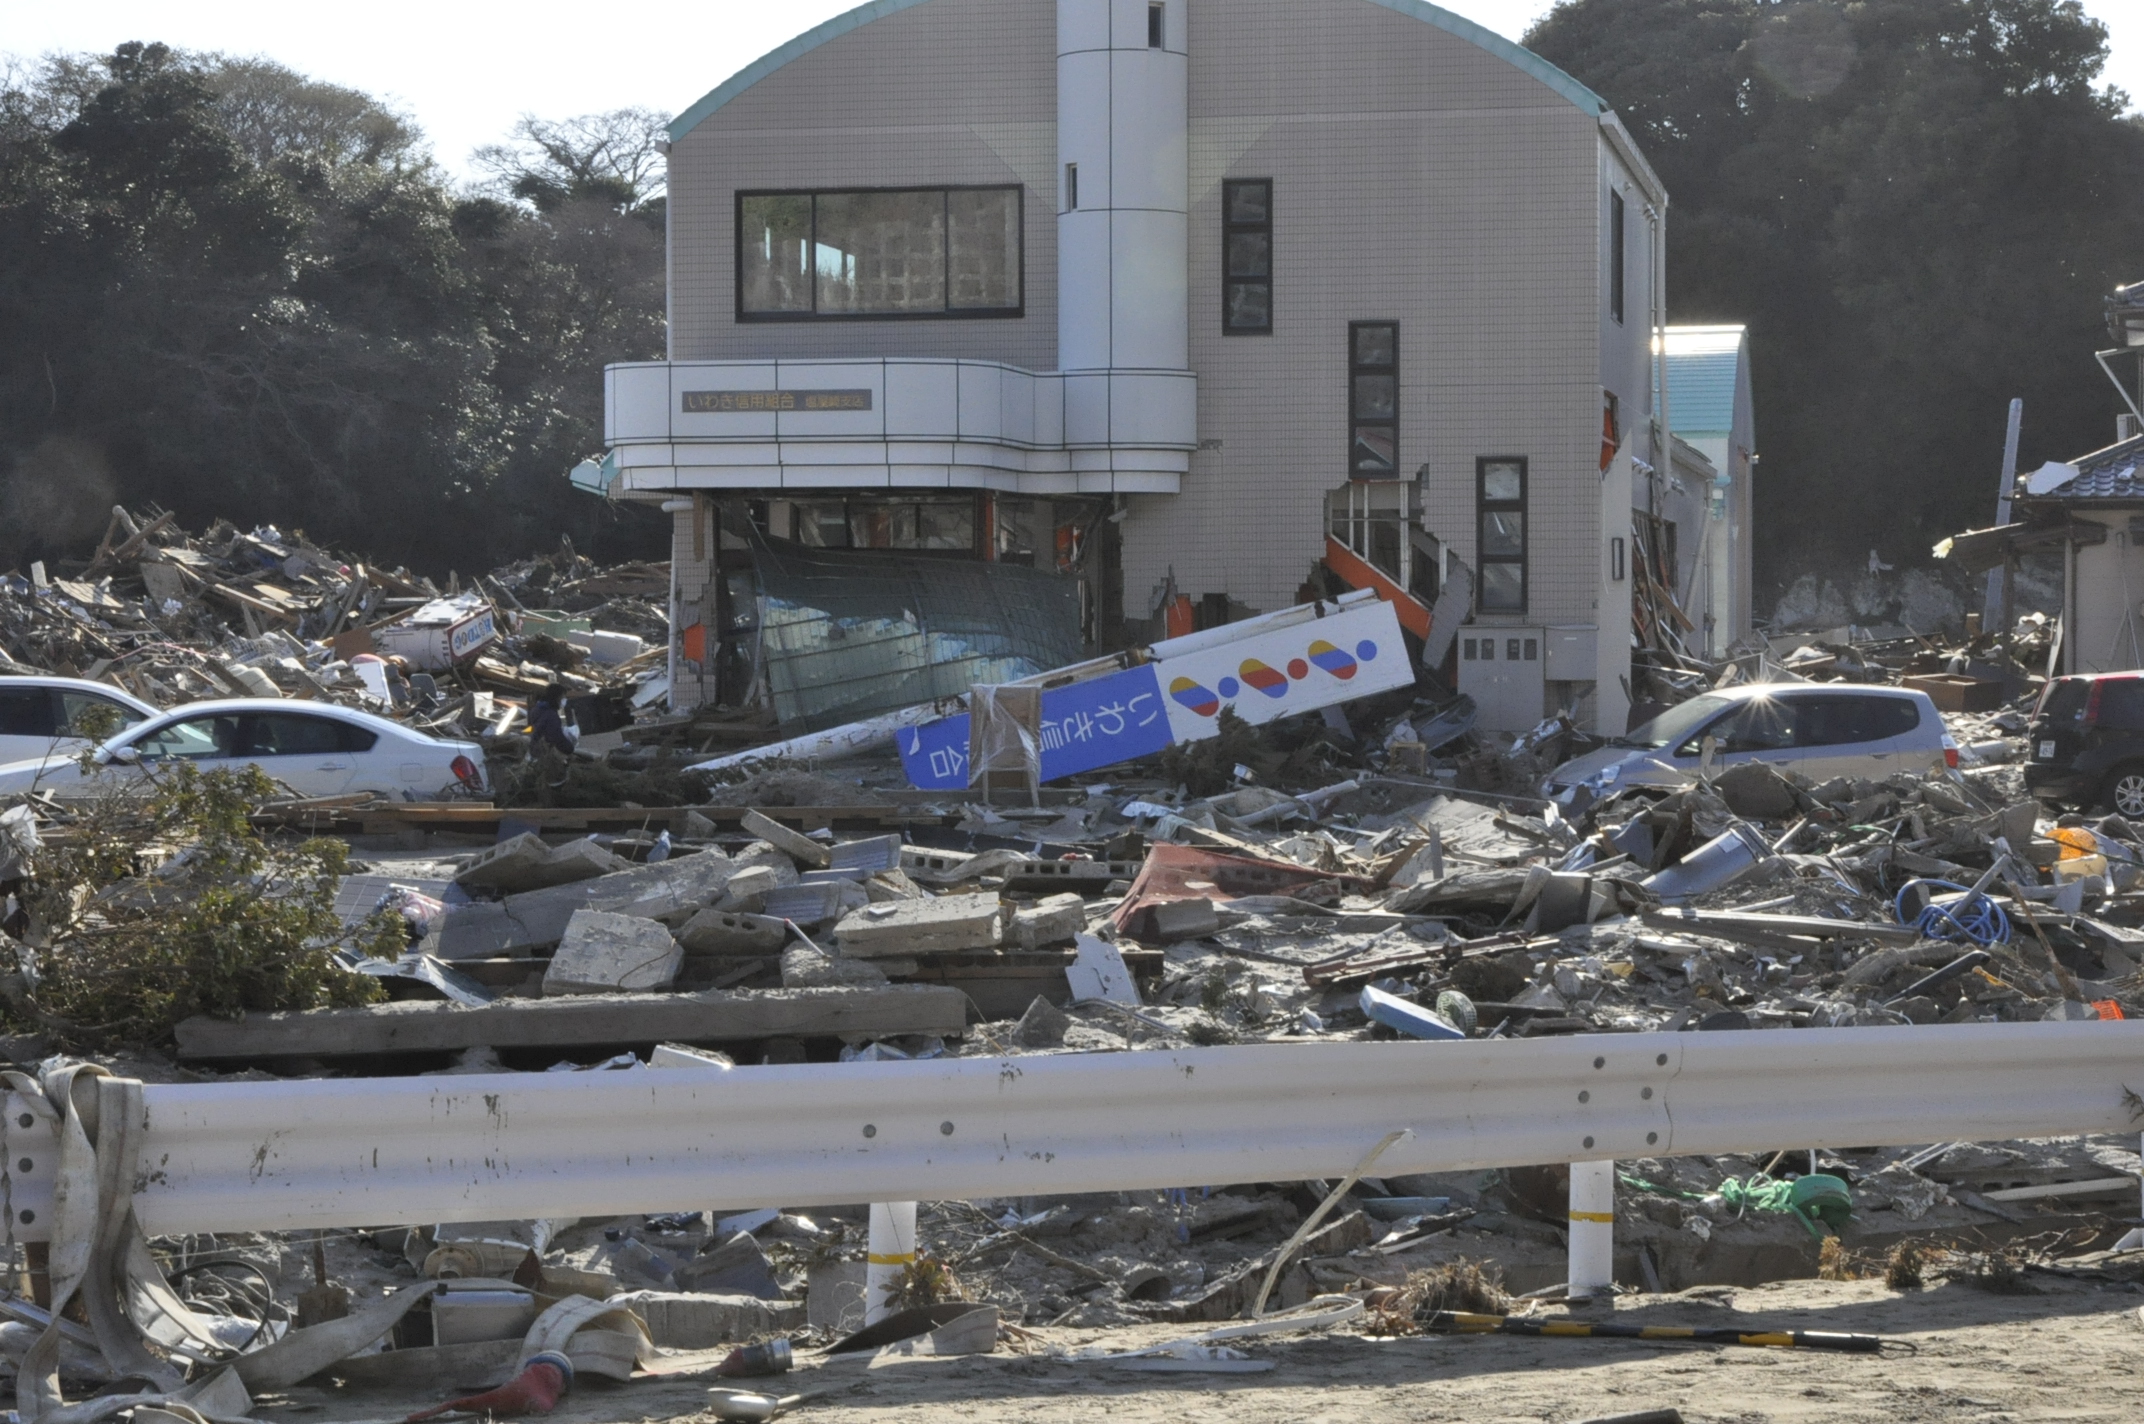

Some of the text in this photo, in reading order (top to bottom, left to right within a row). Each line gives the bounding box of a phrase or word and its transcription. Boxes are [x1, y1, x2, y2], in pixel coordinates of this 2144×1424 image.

[688, 393, 794, 409] いわき信用組合
[929, 693, 1157, 778] いわき信合
